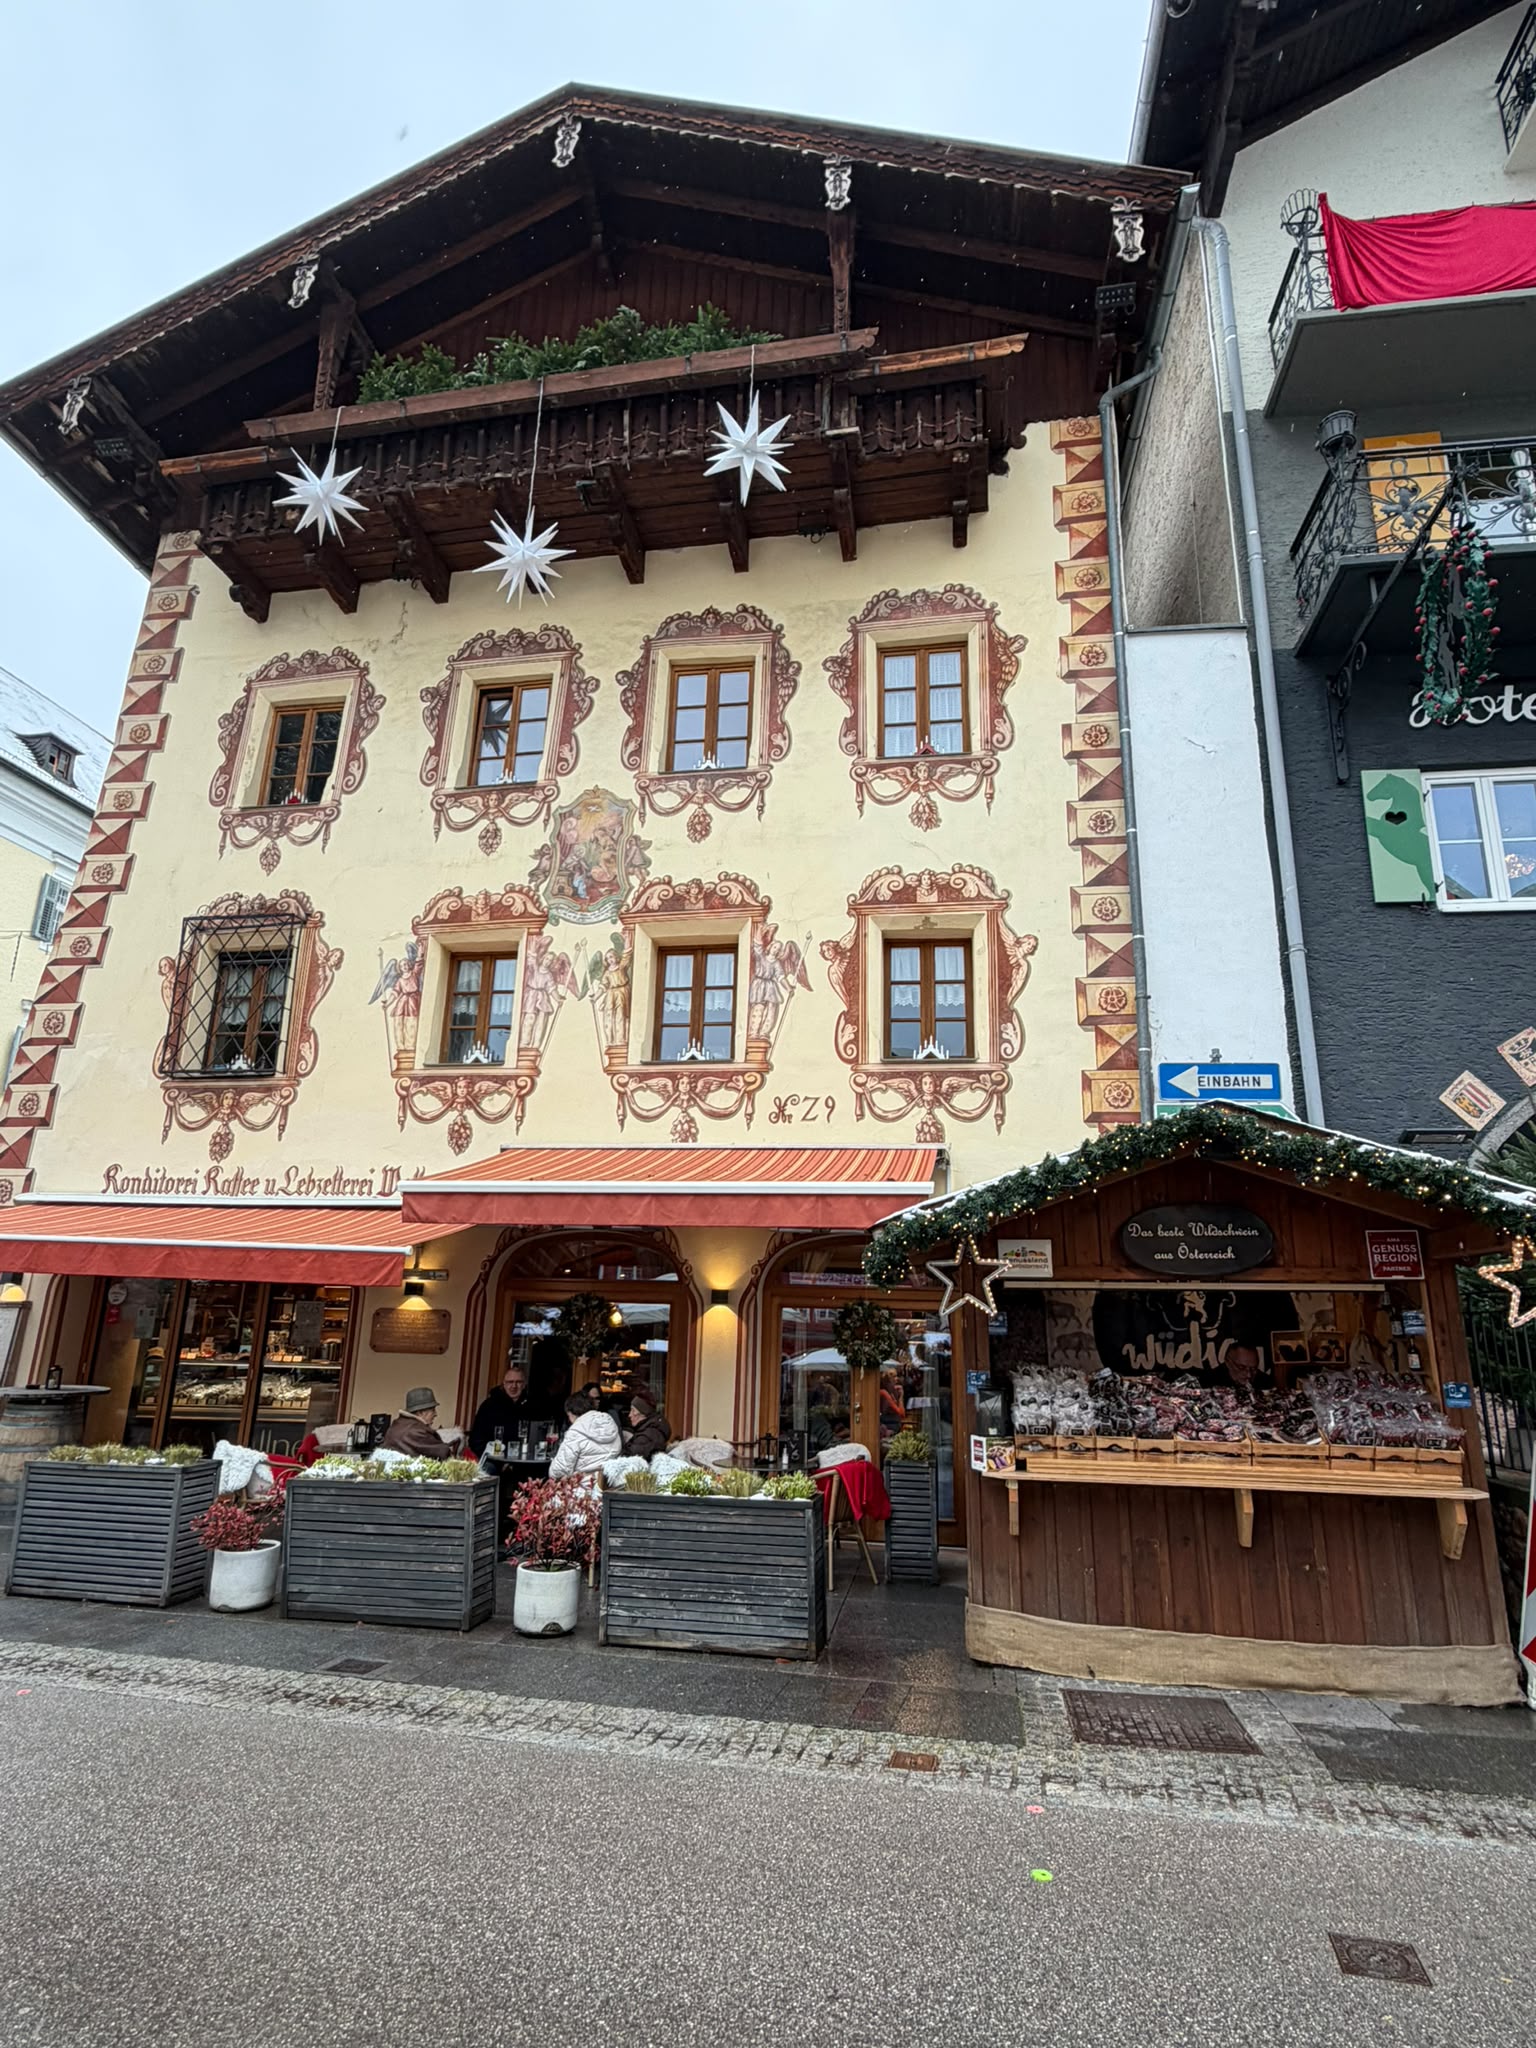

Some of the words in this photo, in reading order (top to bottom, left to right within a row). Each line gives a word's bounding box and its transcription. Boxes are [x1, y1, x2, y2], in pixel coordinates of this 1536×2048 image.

[1198, 1076, 1261, 1087] EINBAHN
[801, 1095, 836, 1124] 29
[101, 1163, 200, 1195] Konditorei
[201, 1165, 261, 1197] Kaffee
[1128, 1222, 1154, 1238] Das
[1157, 1224, 1185, 1238] beste
[1188, 1222, 1260, 1238] Wildschwein
[1154, 1251, 1174, 1260] aus
[1177, 1242, 1236, 1260] Österreich
[1372, 1244, 1417, 1253] GENUSS
[1374, 1254, 1418, 1263] REGION
